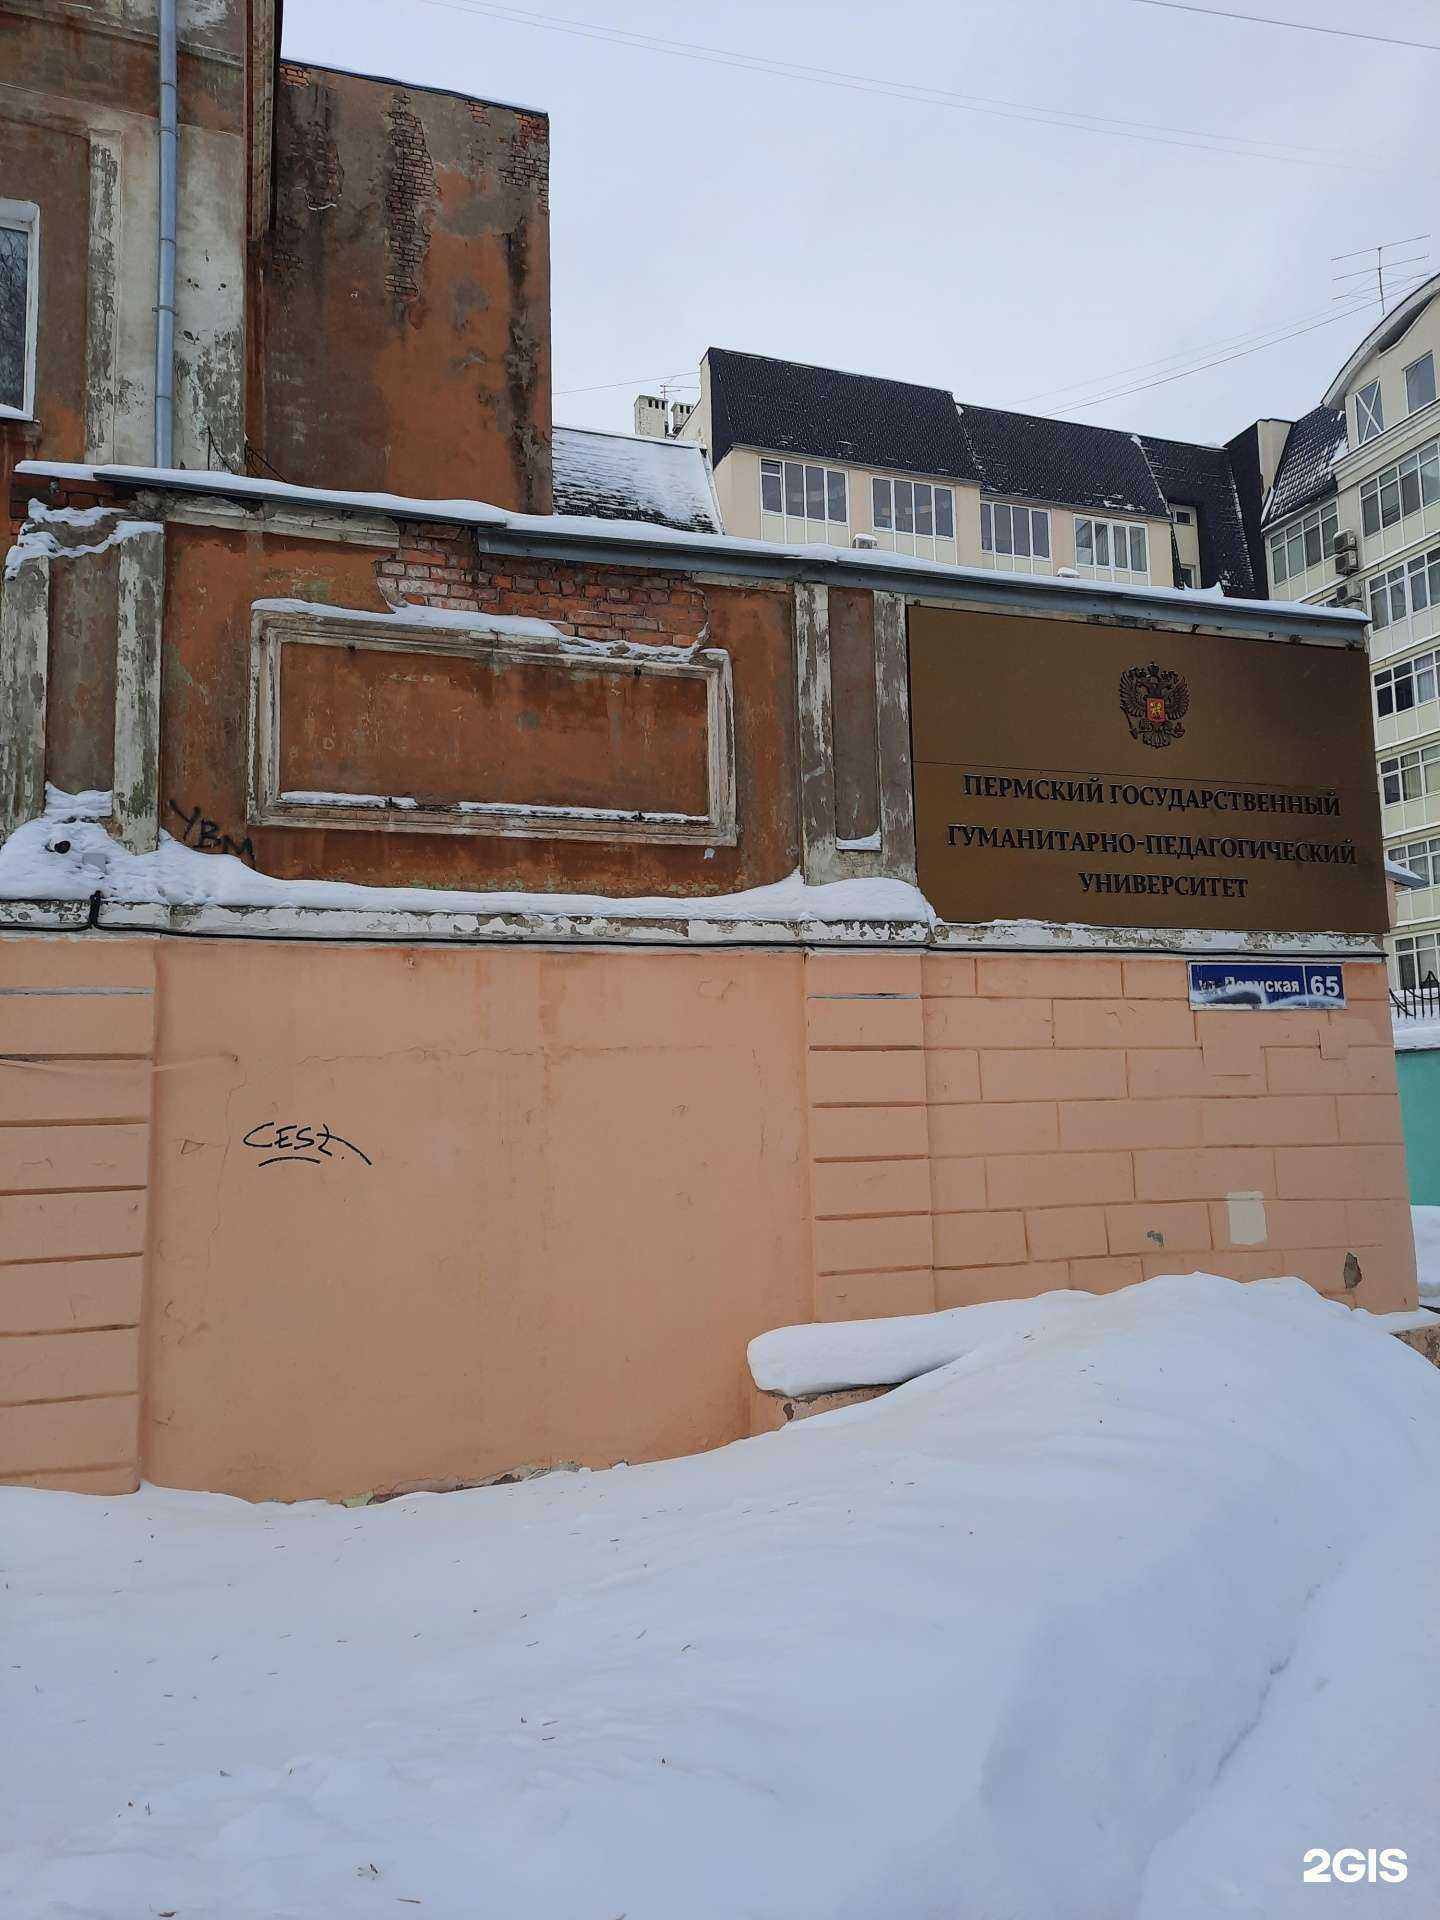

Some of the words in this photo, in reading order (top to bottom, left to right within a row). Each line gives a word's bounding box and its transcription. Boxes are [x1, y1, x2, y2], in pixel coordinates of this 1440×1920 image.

[963, 774, 1104, 803] ПЕРМСКИЙ
[1109, 784, 1341, 816] ГОСУДАРСТВЕННЫЙ
[947, 824, 1358, 865] ГУМАНИТАРНО-ПЕДАГОГИЧЕСКИЙ
[1078, 872, 1249, 898] УНИВЕРСИТЕТ
[1310, 975, 1340, 997] 65
